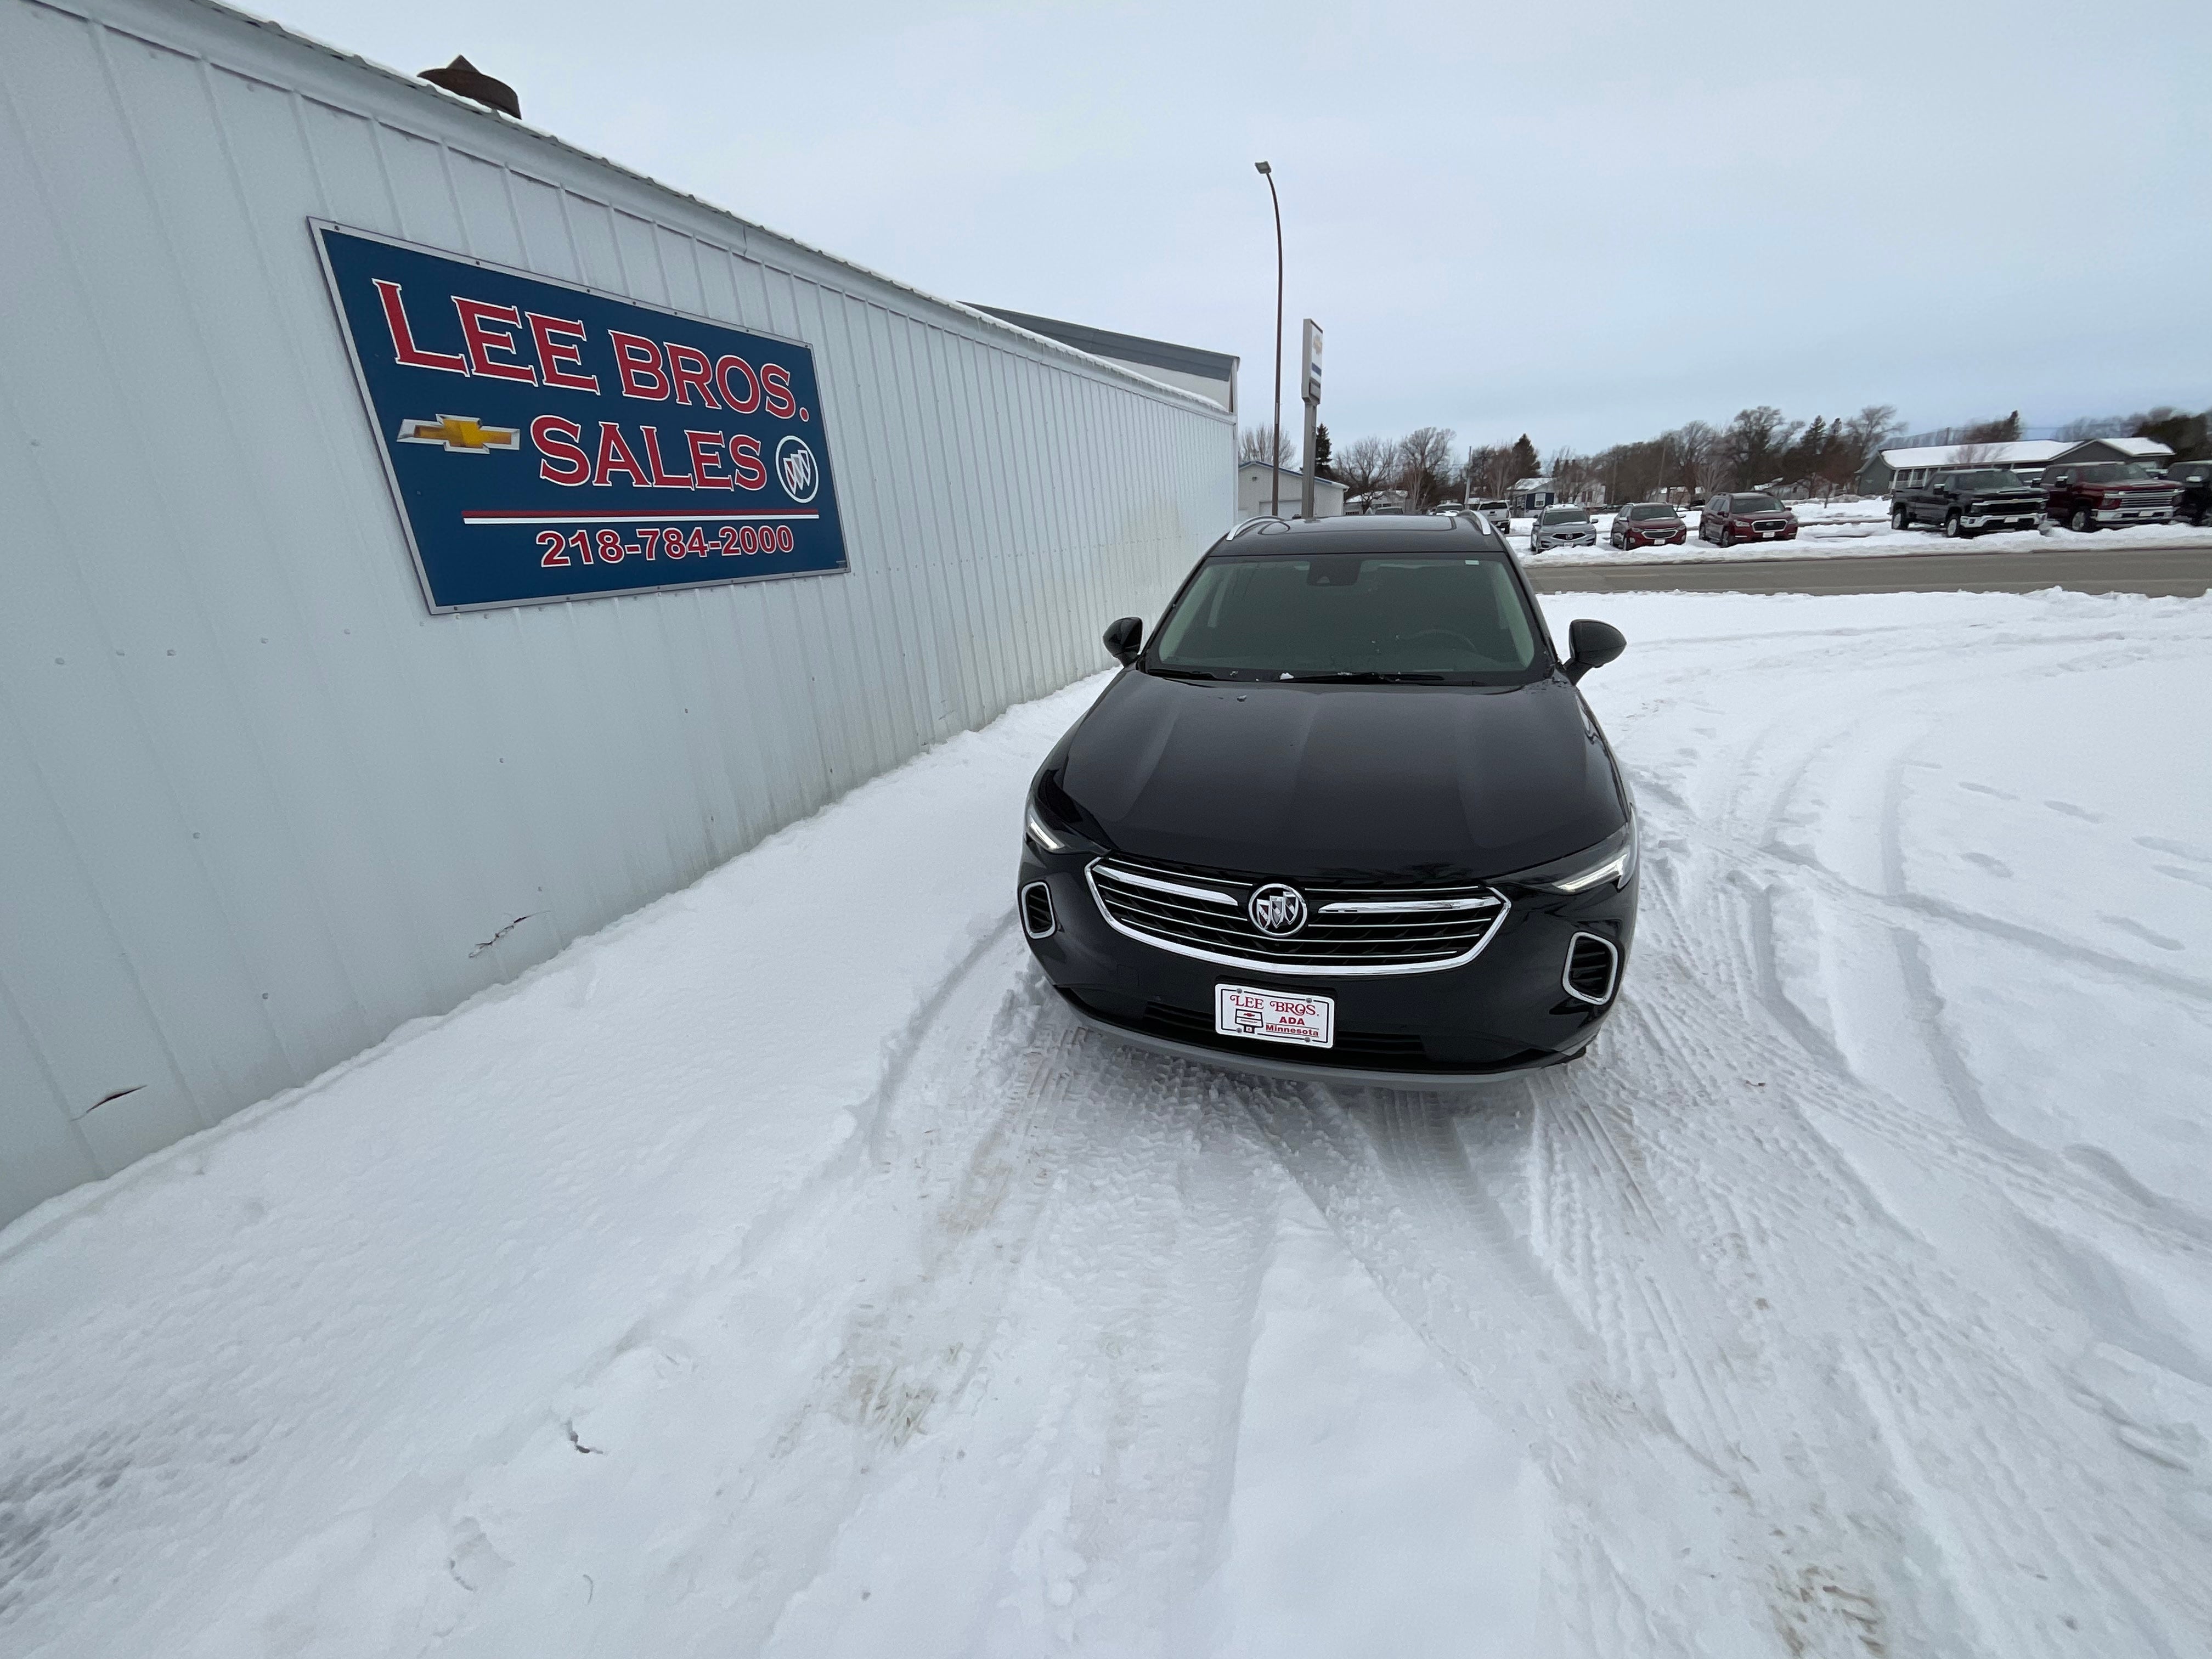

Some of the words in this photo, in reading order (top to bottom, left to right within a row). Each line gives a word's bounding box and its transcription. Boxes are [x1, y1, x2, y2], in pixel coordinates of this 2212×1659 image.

[371, 278, 600, 395] LEE
[608, 330, 810, 422] BROS.
[530, 415, 768, 491] SALES
[536, 525, 794, 567] 218-784-2000
[1230, 995, 1264, 1009] LEE
[1270, 1001, 1319, 1017] BROS.
[1279, 1016, 1305, 1025] ADA
[1266, 1024, 1319, 1036] Minnesota
